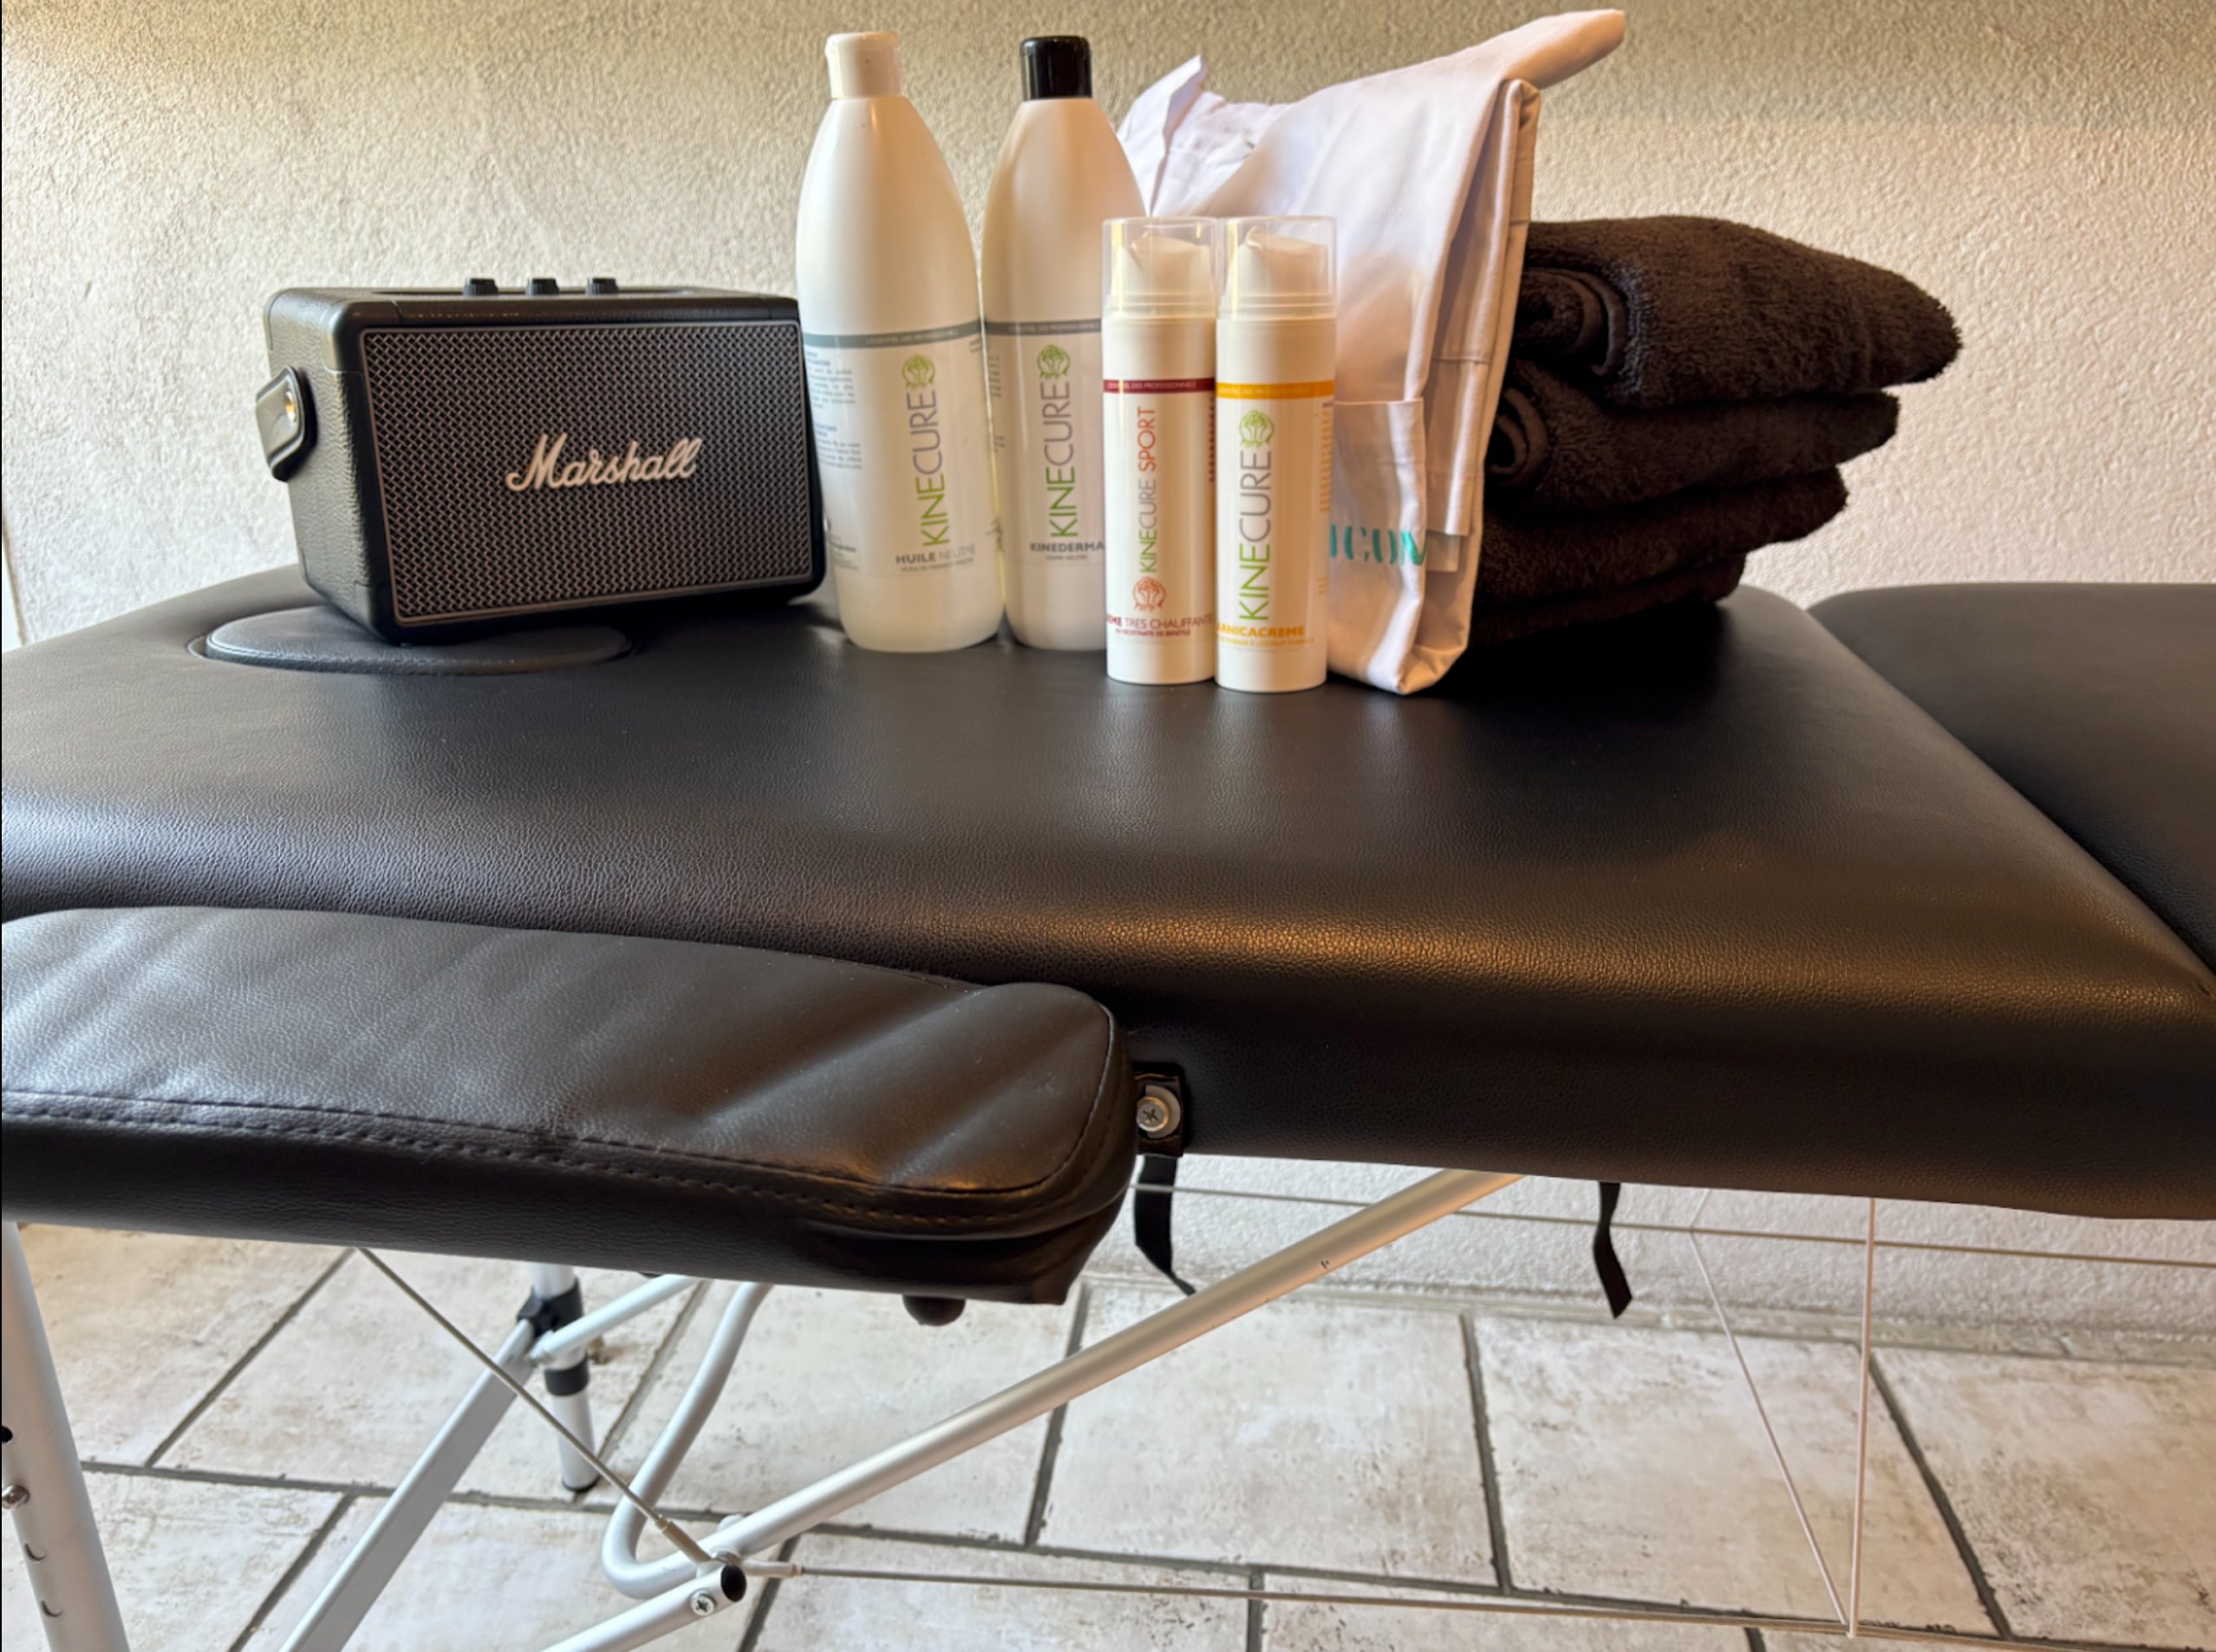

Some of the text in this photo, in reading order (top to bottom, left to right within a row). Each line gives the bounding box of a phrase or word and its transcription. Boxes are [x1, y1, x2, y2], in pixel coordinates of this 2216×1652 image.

[505, 433, 702, 491] Marshall
[906, 390, 951, 547] KINECURE
[1040, 381, 1079, 537] KINECURE
[1137, 406, 1157, 573] KINECURE SPORT
[1239, 451, 1272, 621] KINECURE
[896, 552, 936, 564] HUILE
[1030, 541, 1105, 553] KINEDERMA
